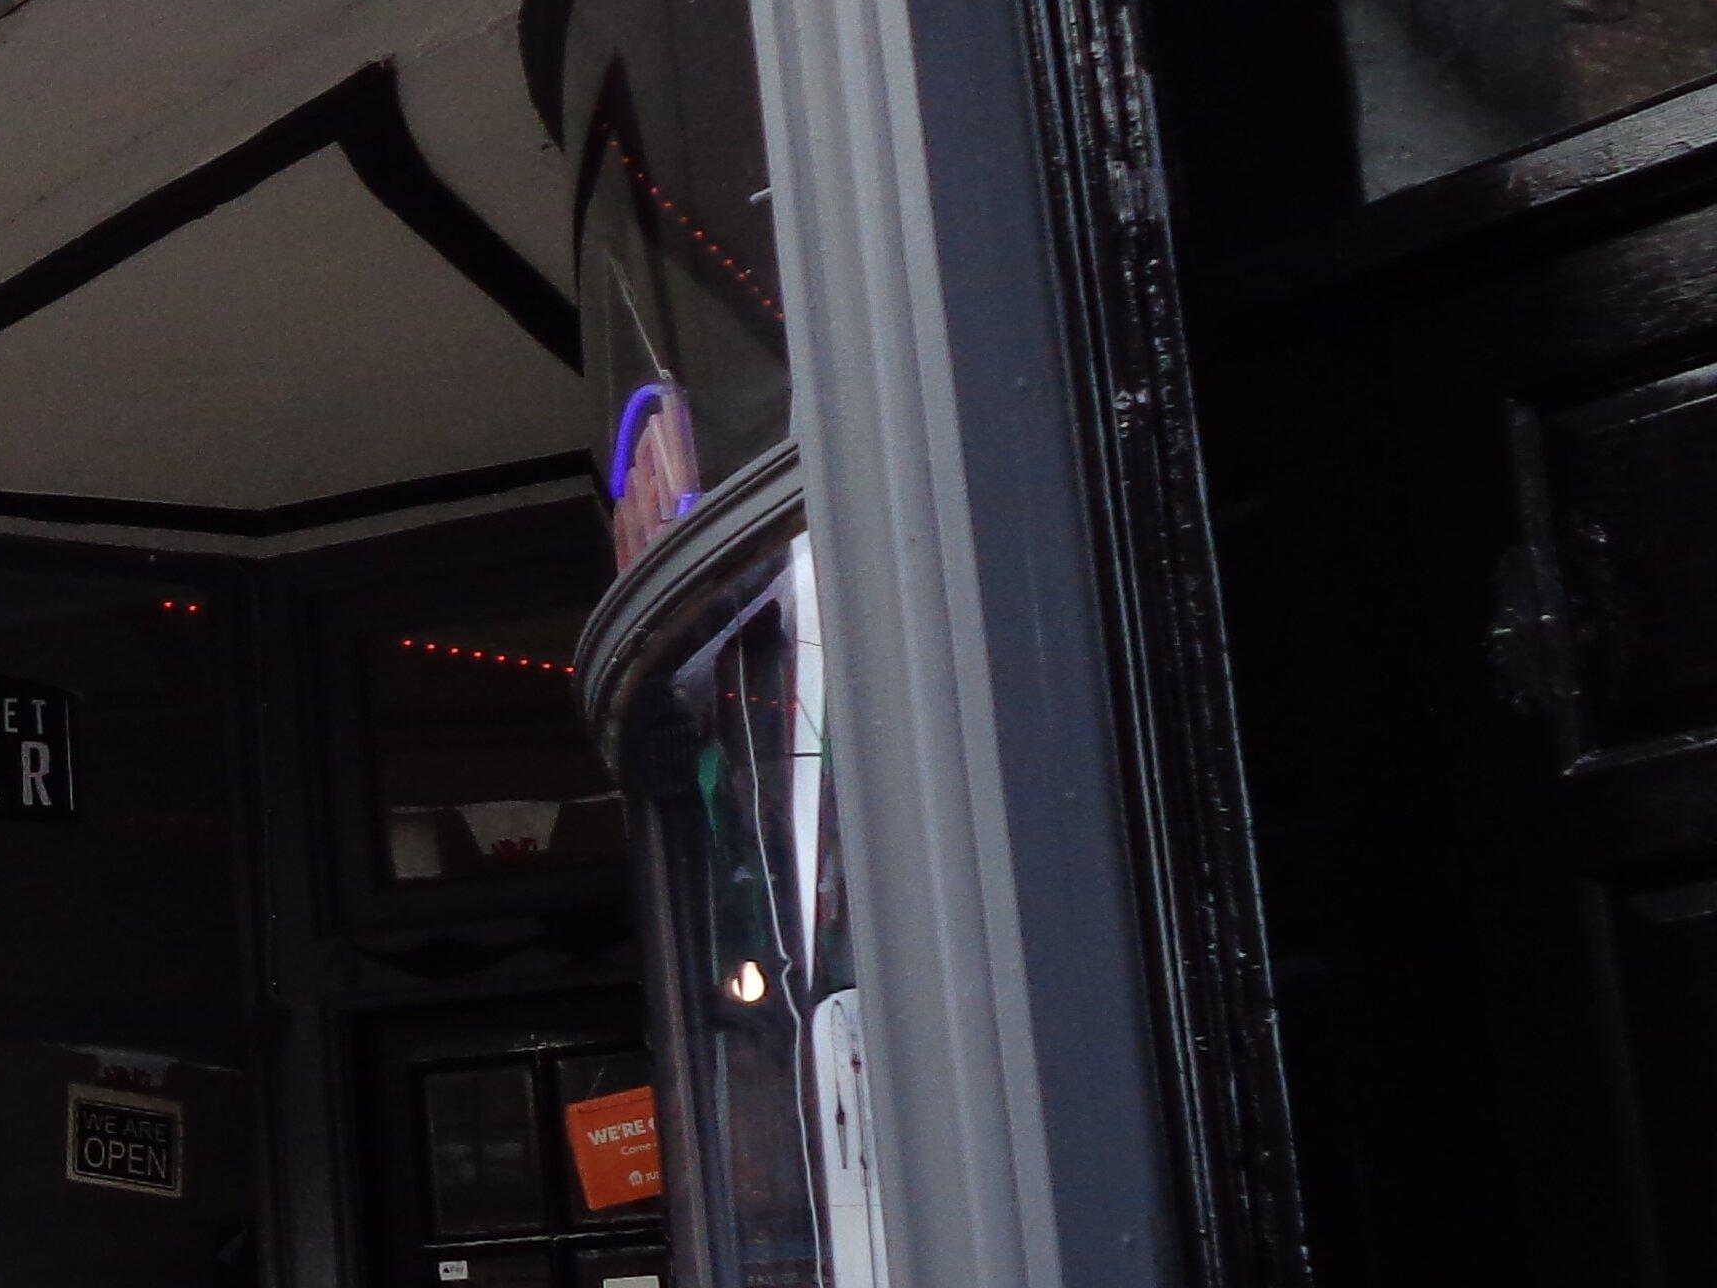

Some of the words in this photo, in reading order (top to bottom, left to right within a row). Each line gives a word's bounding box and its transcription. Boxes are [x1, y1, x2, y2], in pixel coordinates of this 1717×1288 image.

[86, 1113, 118, 1134] WE
[587, 1119, 647, 1146] WE'RE
[85, 1136, 167, 1180] OPEN
